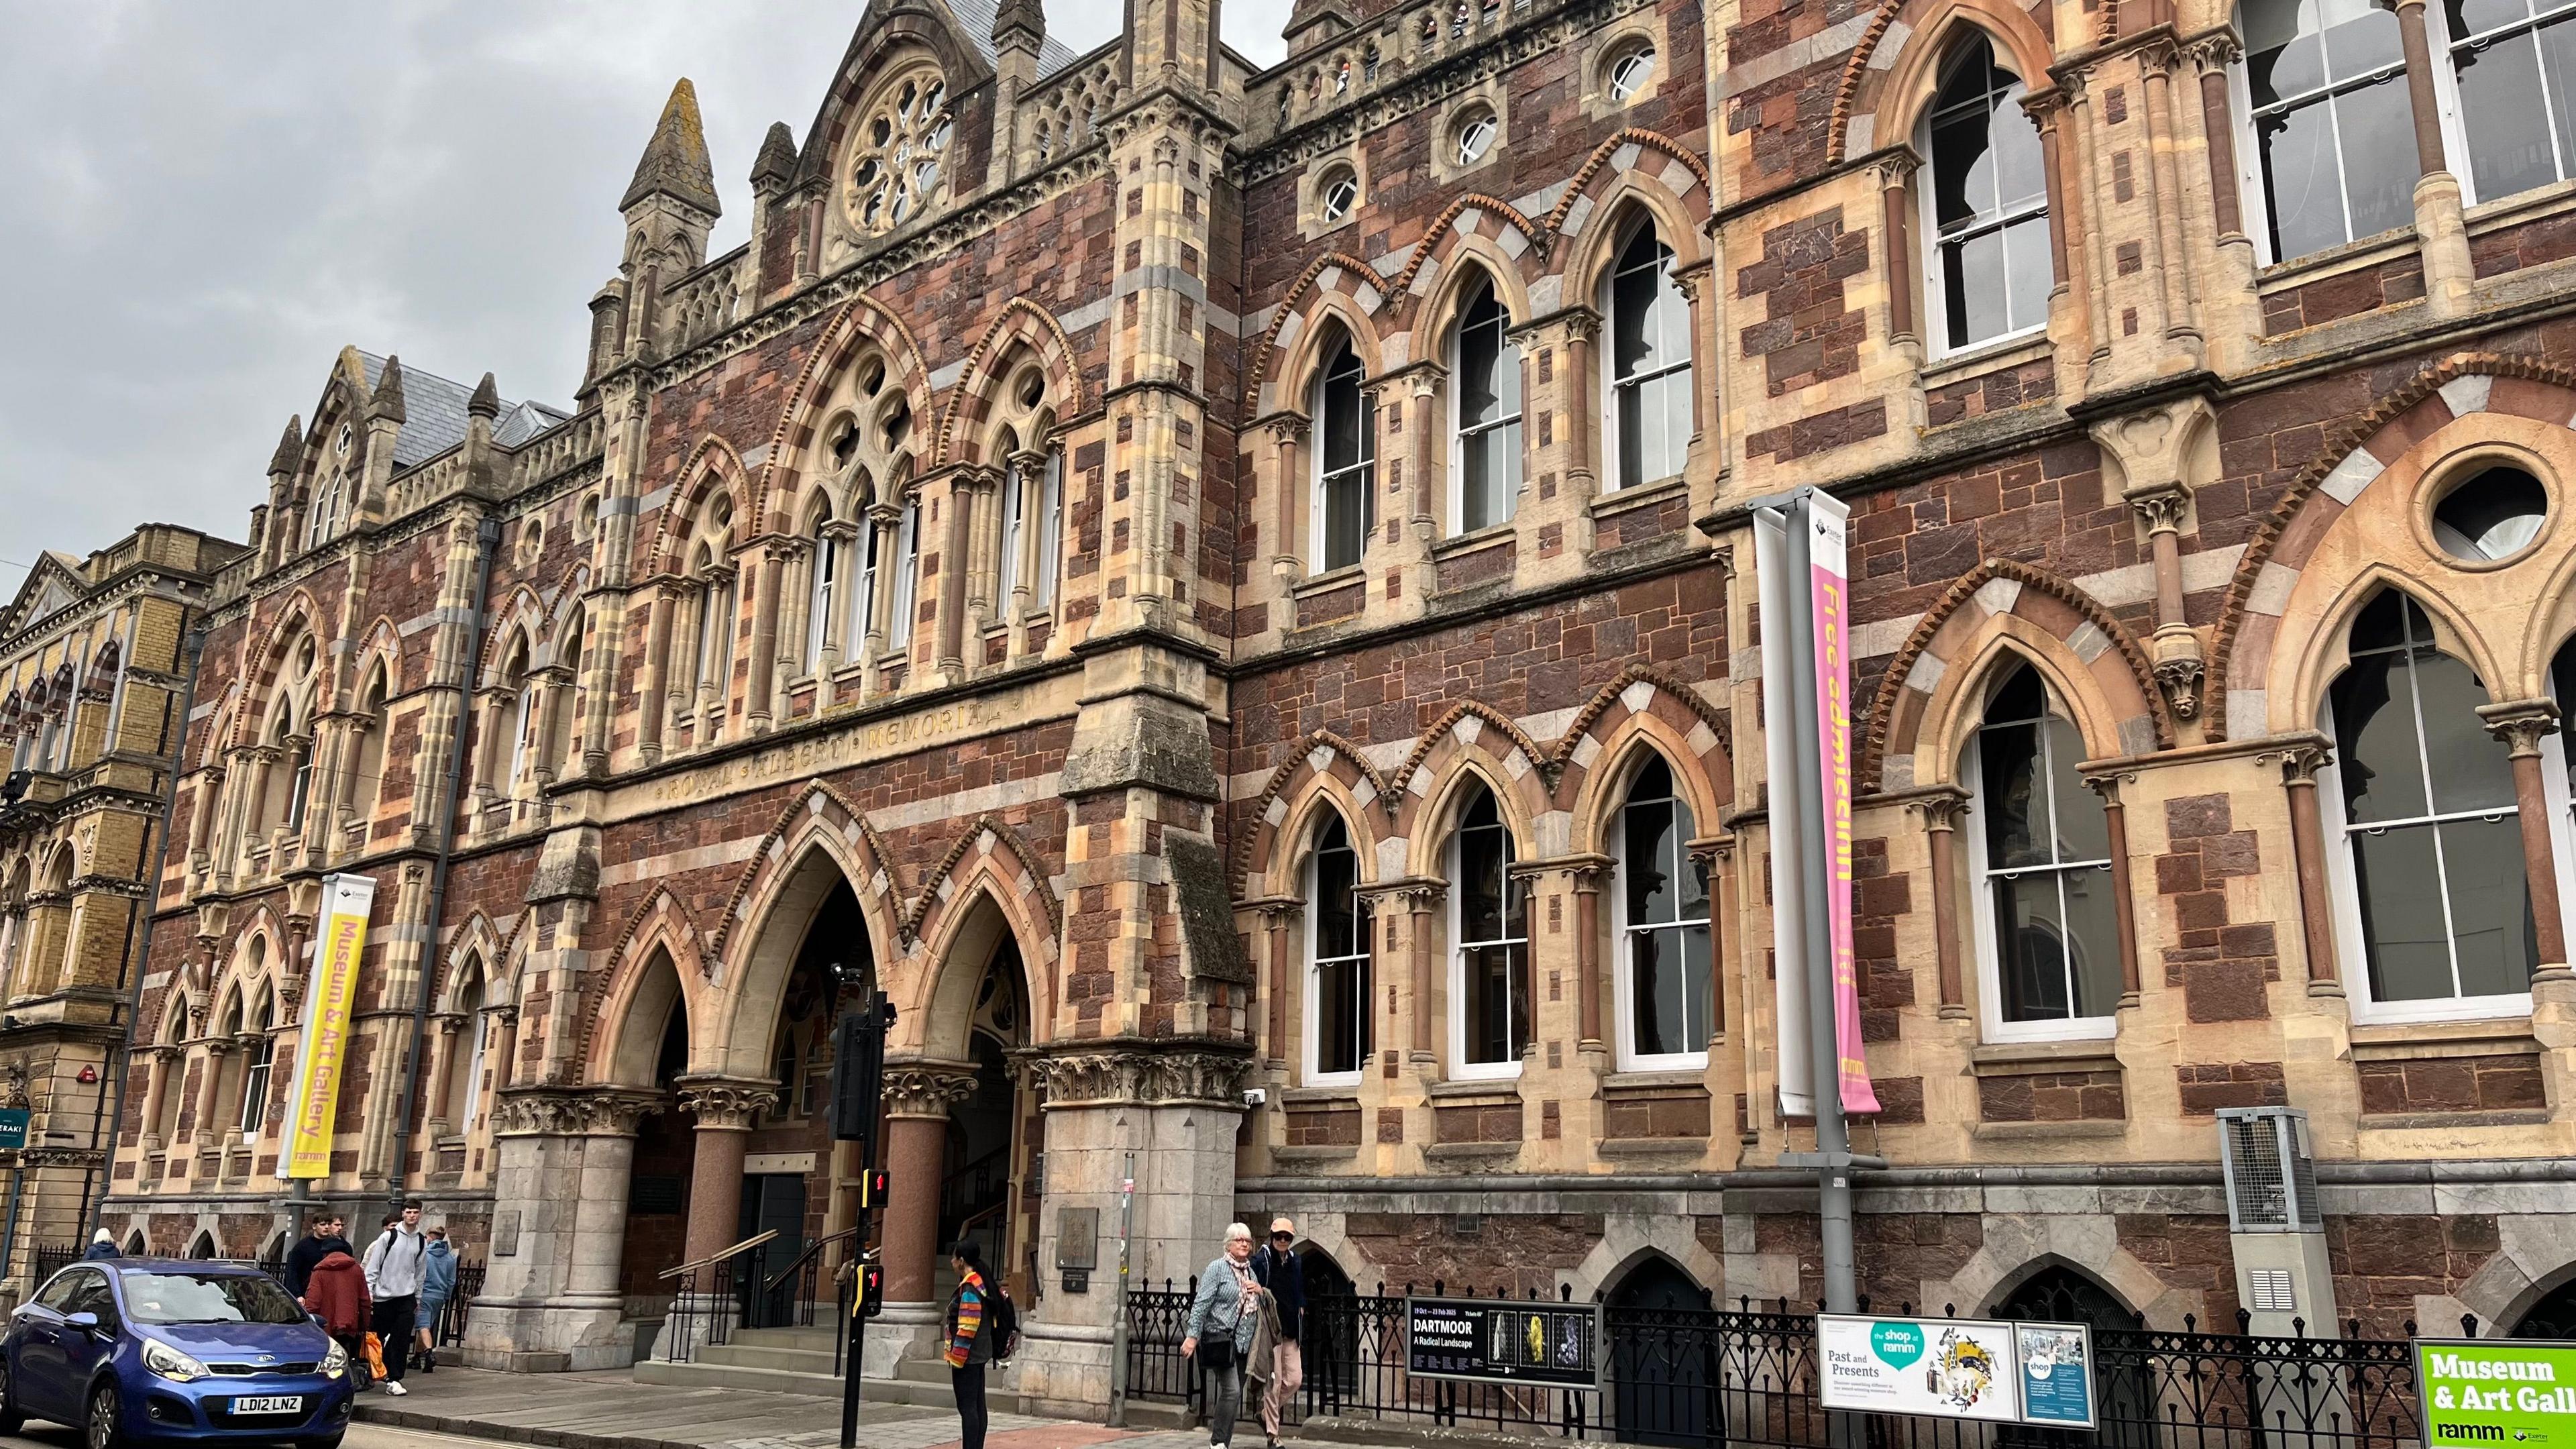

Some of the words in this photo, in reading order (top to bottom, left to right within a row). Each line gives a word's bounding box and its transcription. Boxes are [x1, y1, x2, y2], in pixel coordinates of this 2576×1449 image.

[1823, 583, 1840, 668] Free
[667, 765, 733, 800] ROYAL
[754, 737, 843, 779] ALBERT
[868, 699, 1001, 751] MEMORIAL
[328, 920, 358, 1004] Museum
[325, 1008, 344, 1024] &
[318, 1027, 340, 1060] Art
[301, 1065, 333, 1138] Gallery
[295, 1152, 326, 1161] ramm
[1413, 1319, 1472, 1334] DARTMOOR
[1413, 1336, 1419, 1345] A
[1419, 1336, 1440, 1346] Radical
[1441, 1338, 1472, 1350] Landscape
[1885, 1329, 1911, 1344] shop
[1883, 1342, 1916, 1354] ramm
[1828, 1350, 1851, 1362] Past
[1853, 1355, 1867, 1364] and
[1832, 1364, 1879, 1378] Presents
[2030, 1362, 2049, 1372] shop
[2430, 1353, 2556, 1381] Museum
[239, 1399, 270, 1411] LD12
[272, 1397, 298, 1410] LNZ
[2434, 1385, 2456, 1409] &
[2460, 1385, 2513, 1411] Art
[2516, 1386, 2576, 1414] Gall
[2436, 1422, 2505, 1441] ramm
